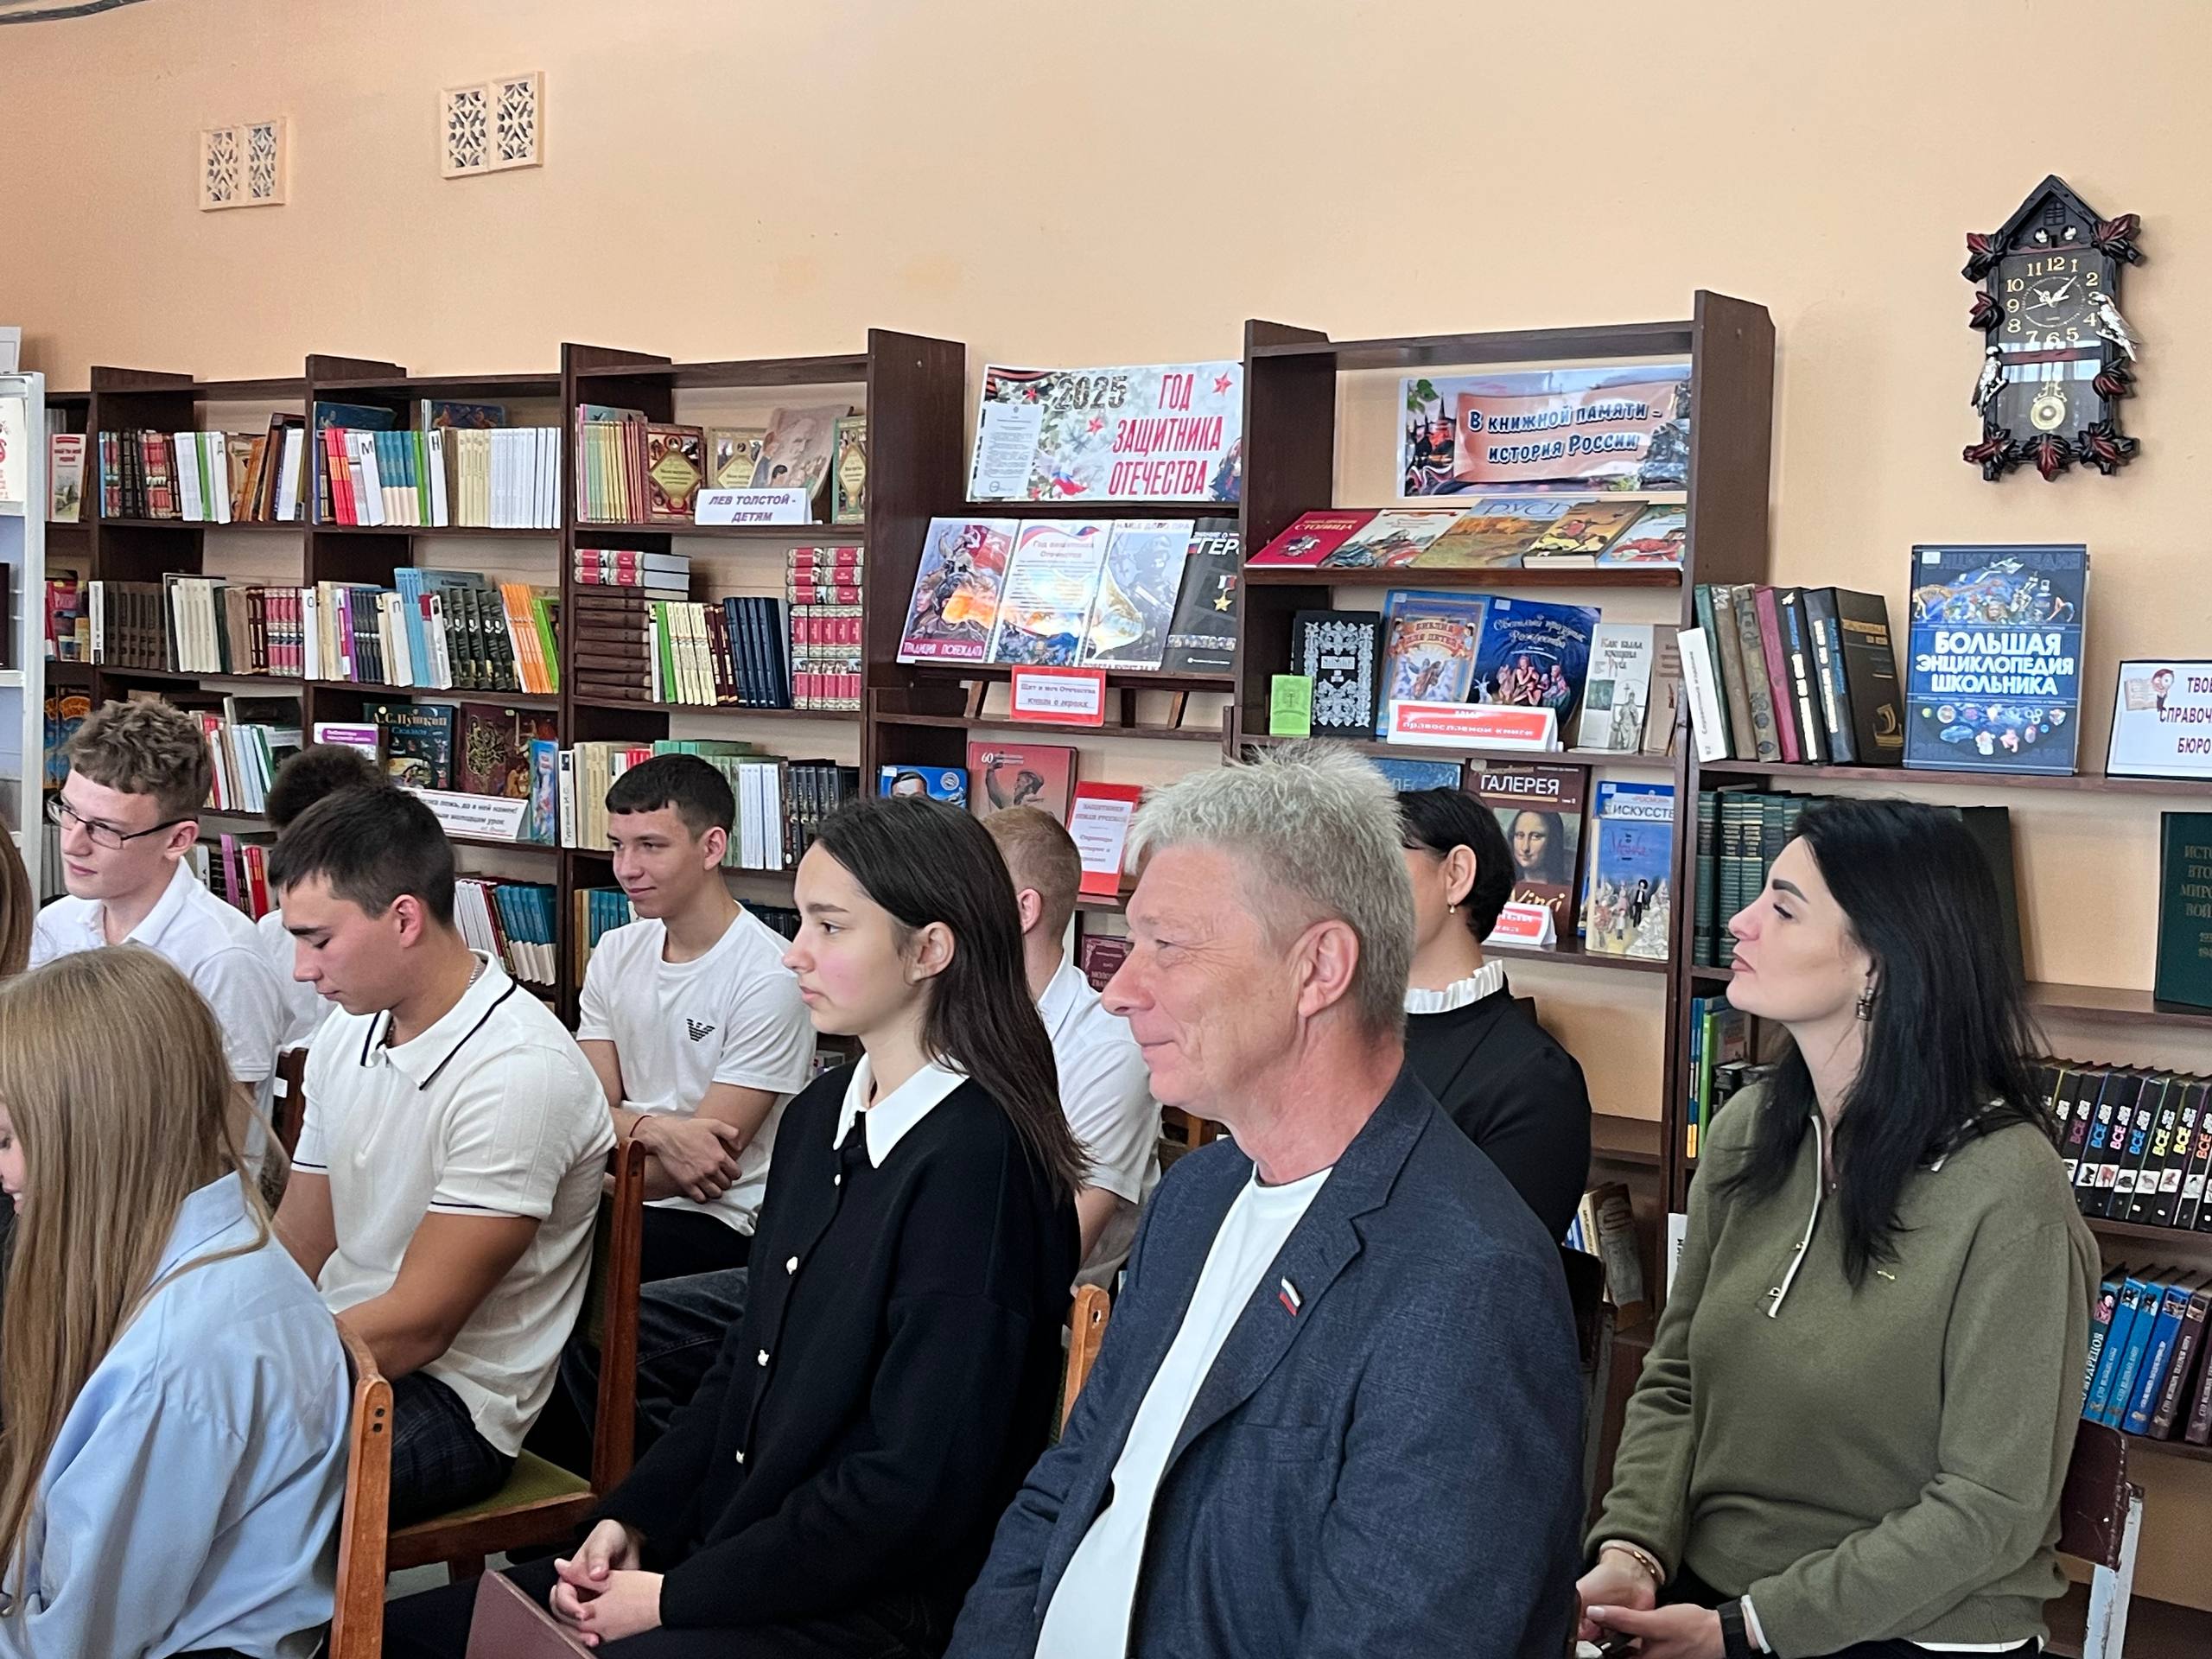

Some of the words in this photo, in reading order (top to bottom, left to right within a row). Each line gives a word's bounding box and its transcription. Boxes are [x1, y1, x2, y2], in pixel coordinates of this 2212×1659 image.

[2027, 263, 2043, 276] 11
[2047, 257, 2065, 271] 12
[2070, 259, 2078, 272] 1
[2006, 280, 2024, 292] 10
[2086, 272, 2098, 286] 2
[2007, 299, 2019, 313] 9
[2007, 320, 2021, 333] 8
[2083, 313, 2097, 327] 4
[2026, 331, 2039, 344] 7
[2047, 332, 2060, 347] 6
[2067, 328, 2079, 341] 5
[1053, 375, 1127, 410] 2025
[1159, 373, 1194, 411] ГОД
[1468, 410, 1484, 431] В
[431, 435, 440, 451] Н
[1112, 416, 1223, 457] ЗАЩИТНИКА
[361, 440, 374, 455] М
[1108, 460, 1208, 495] ОТЕЧЕСТВА
[709, 496, 733, 505] ЛЕВ
[736, 493, 790, 505] ТОЛСТОЙ
[731, 512, 773, 523] ДЕТЯМ
[1197, 538, 1239, 555] ГЕР
[1935, 632, 2062, 656] БОЛЬШАЯ
[1916, 654, 2075, 676] ЭНЦИКЛОПЕДИЯ
[1931, 674, 2058, 696] ШКОЛЬНИКА
[2177, 738, 2211, 753] БЮРО
[982, 752, 994, 764] 60
[1480, 774, 1560, 796] ГАЛЕРЕЯ
[2091, 1124, 2107, 1148] ВСЕ
[2110, 1125, 2126, 1150] ВСЕ
[2129, 1128, 2145, 1154] ВСЕ
[2152, 1128, 2171, 1157] ВСЕ
[2173, 1126, 2191, 1155] ВСЕ
[2196, 1133, 2212, 1160] ВСЕ
